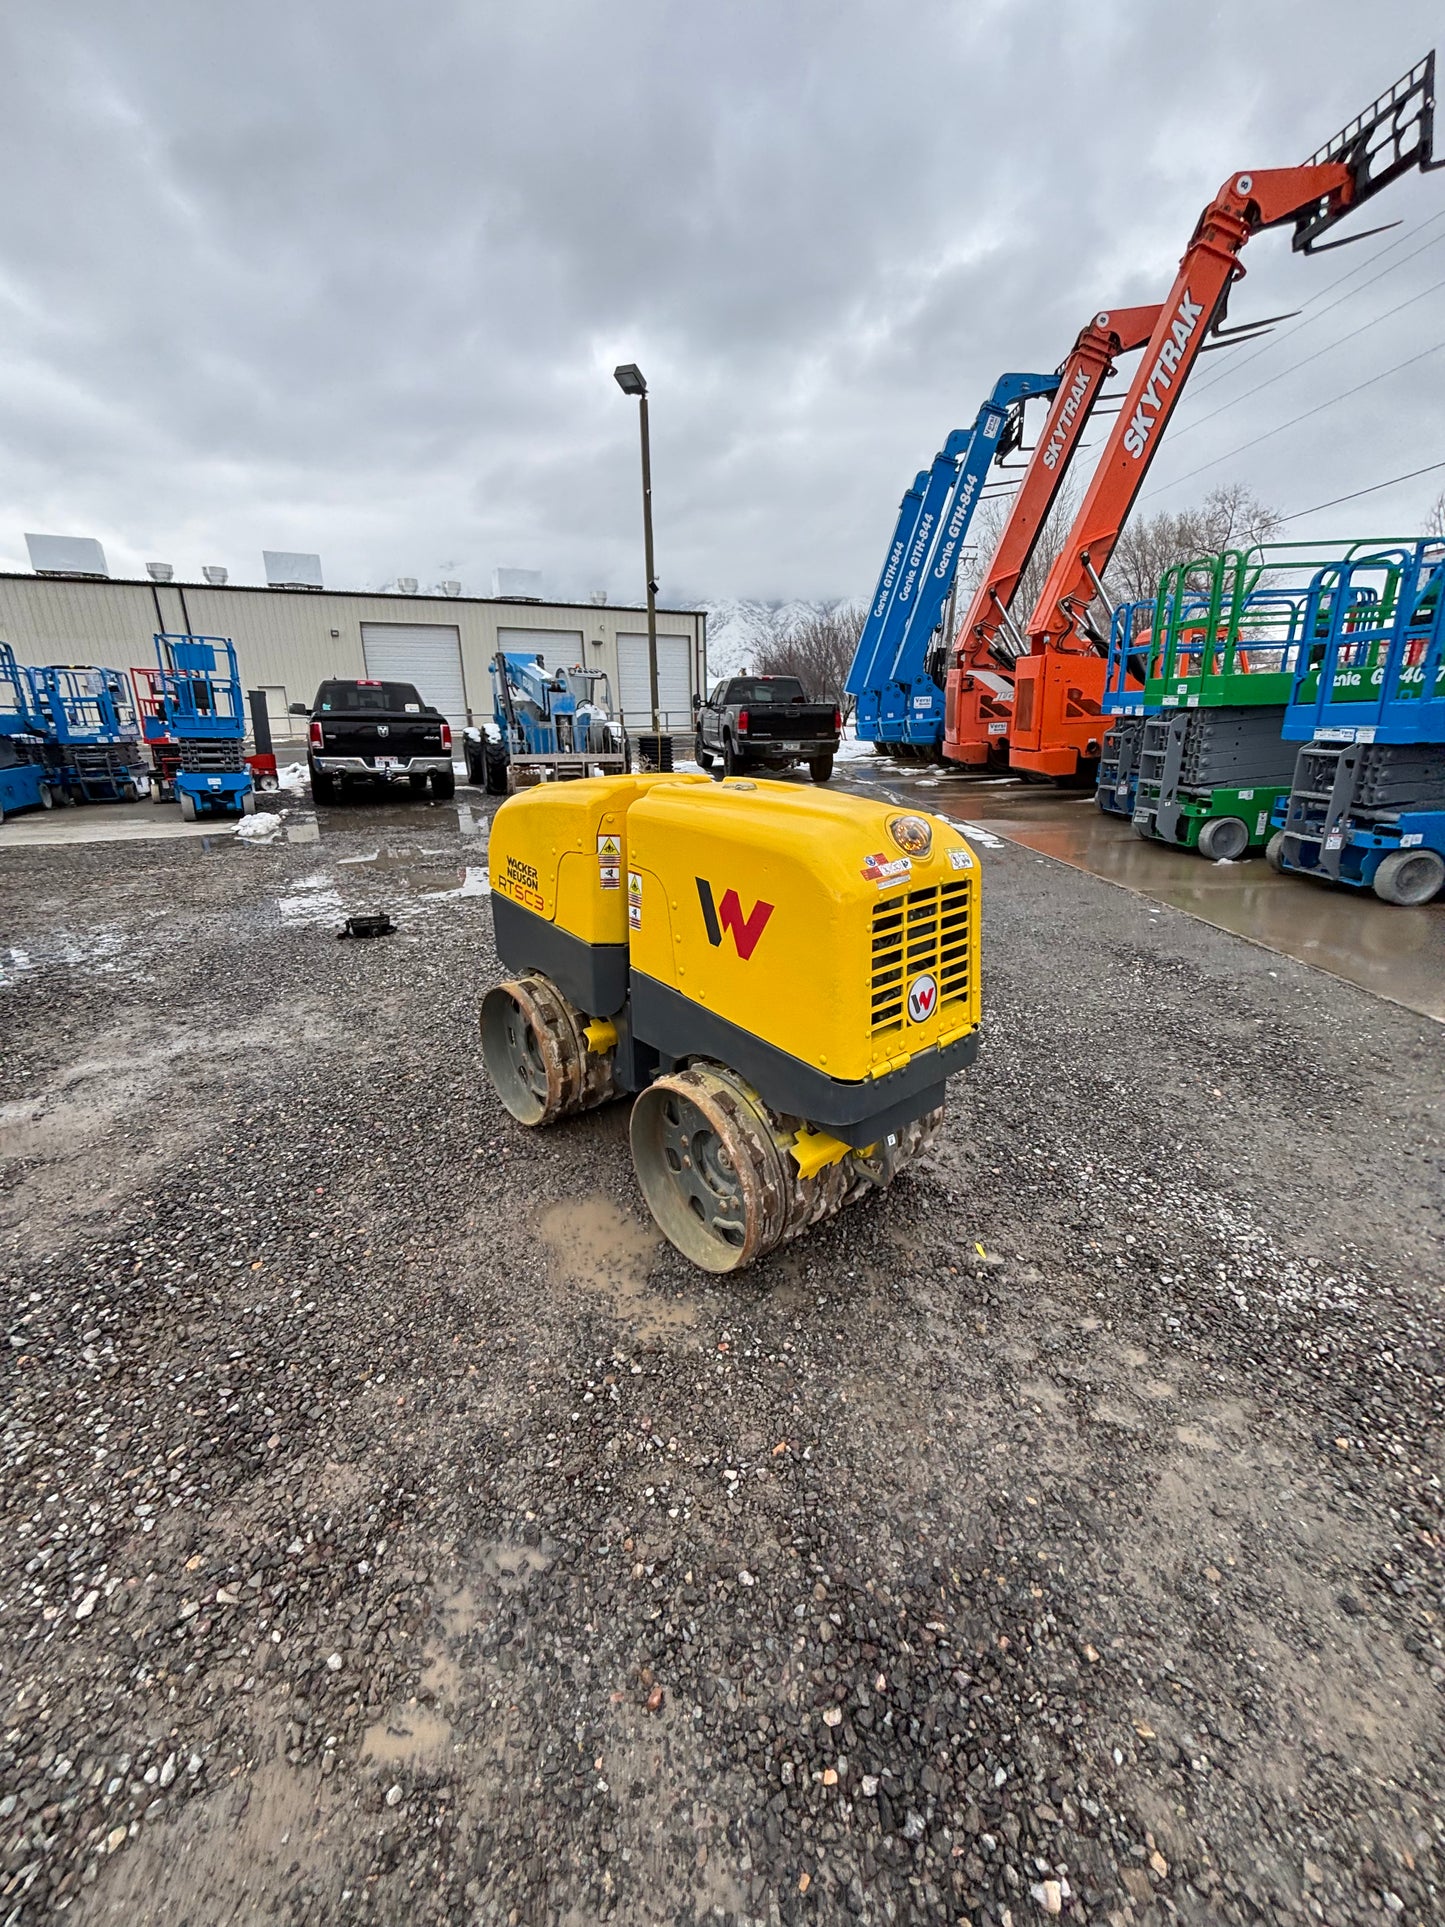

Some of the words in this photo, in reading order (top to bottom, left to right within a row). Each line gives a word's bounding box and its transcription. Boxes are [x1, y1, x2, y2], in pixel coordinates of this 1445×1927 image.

[1123, 286, 1205, 459] SKYTRAK
[1043, 365, 1091, 470] SKYTRAK
[899, 570, 916, 601] Genie
[910, 512, 934, 568] GTH-844
[934, 540, 956, 578] Genie
[948, 473, 979, 538] GTH-844
[873, 589, 889, 617] Genie
[884, 541, 905, 588] GTH-844
[506, 854, 538, 880] WACKER
[507, 866, 538, 891] NEUSON
